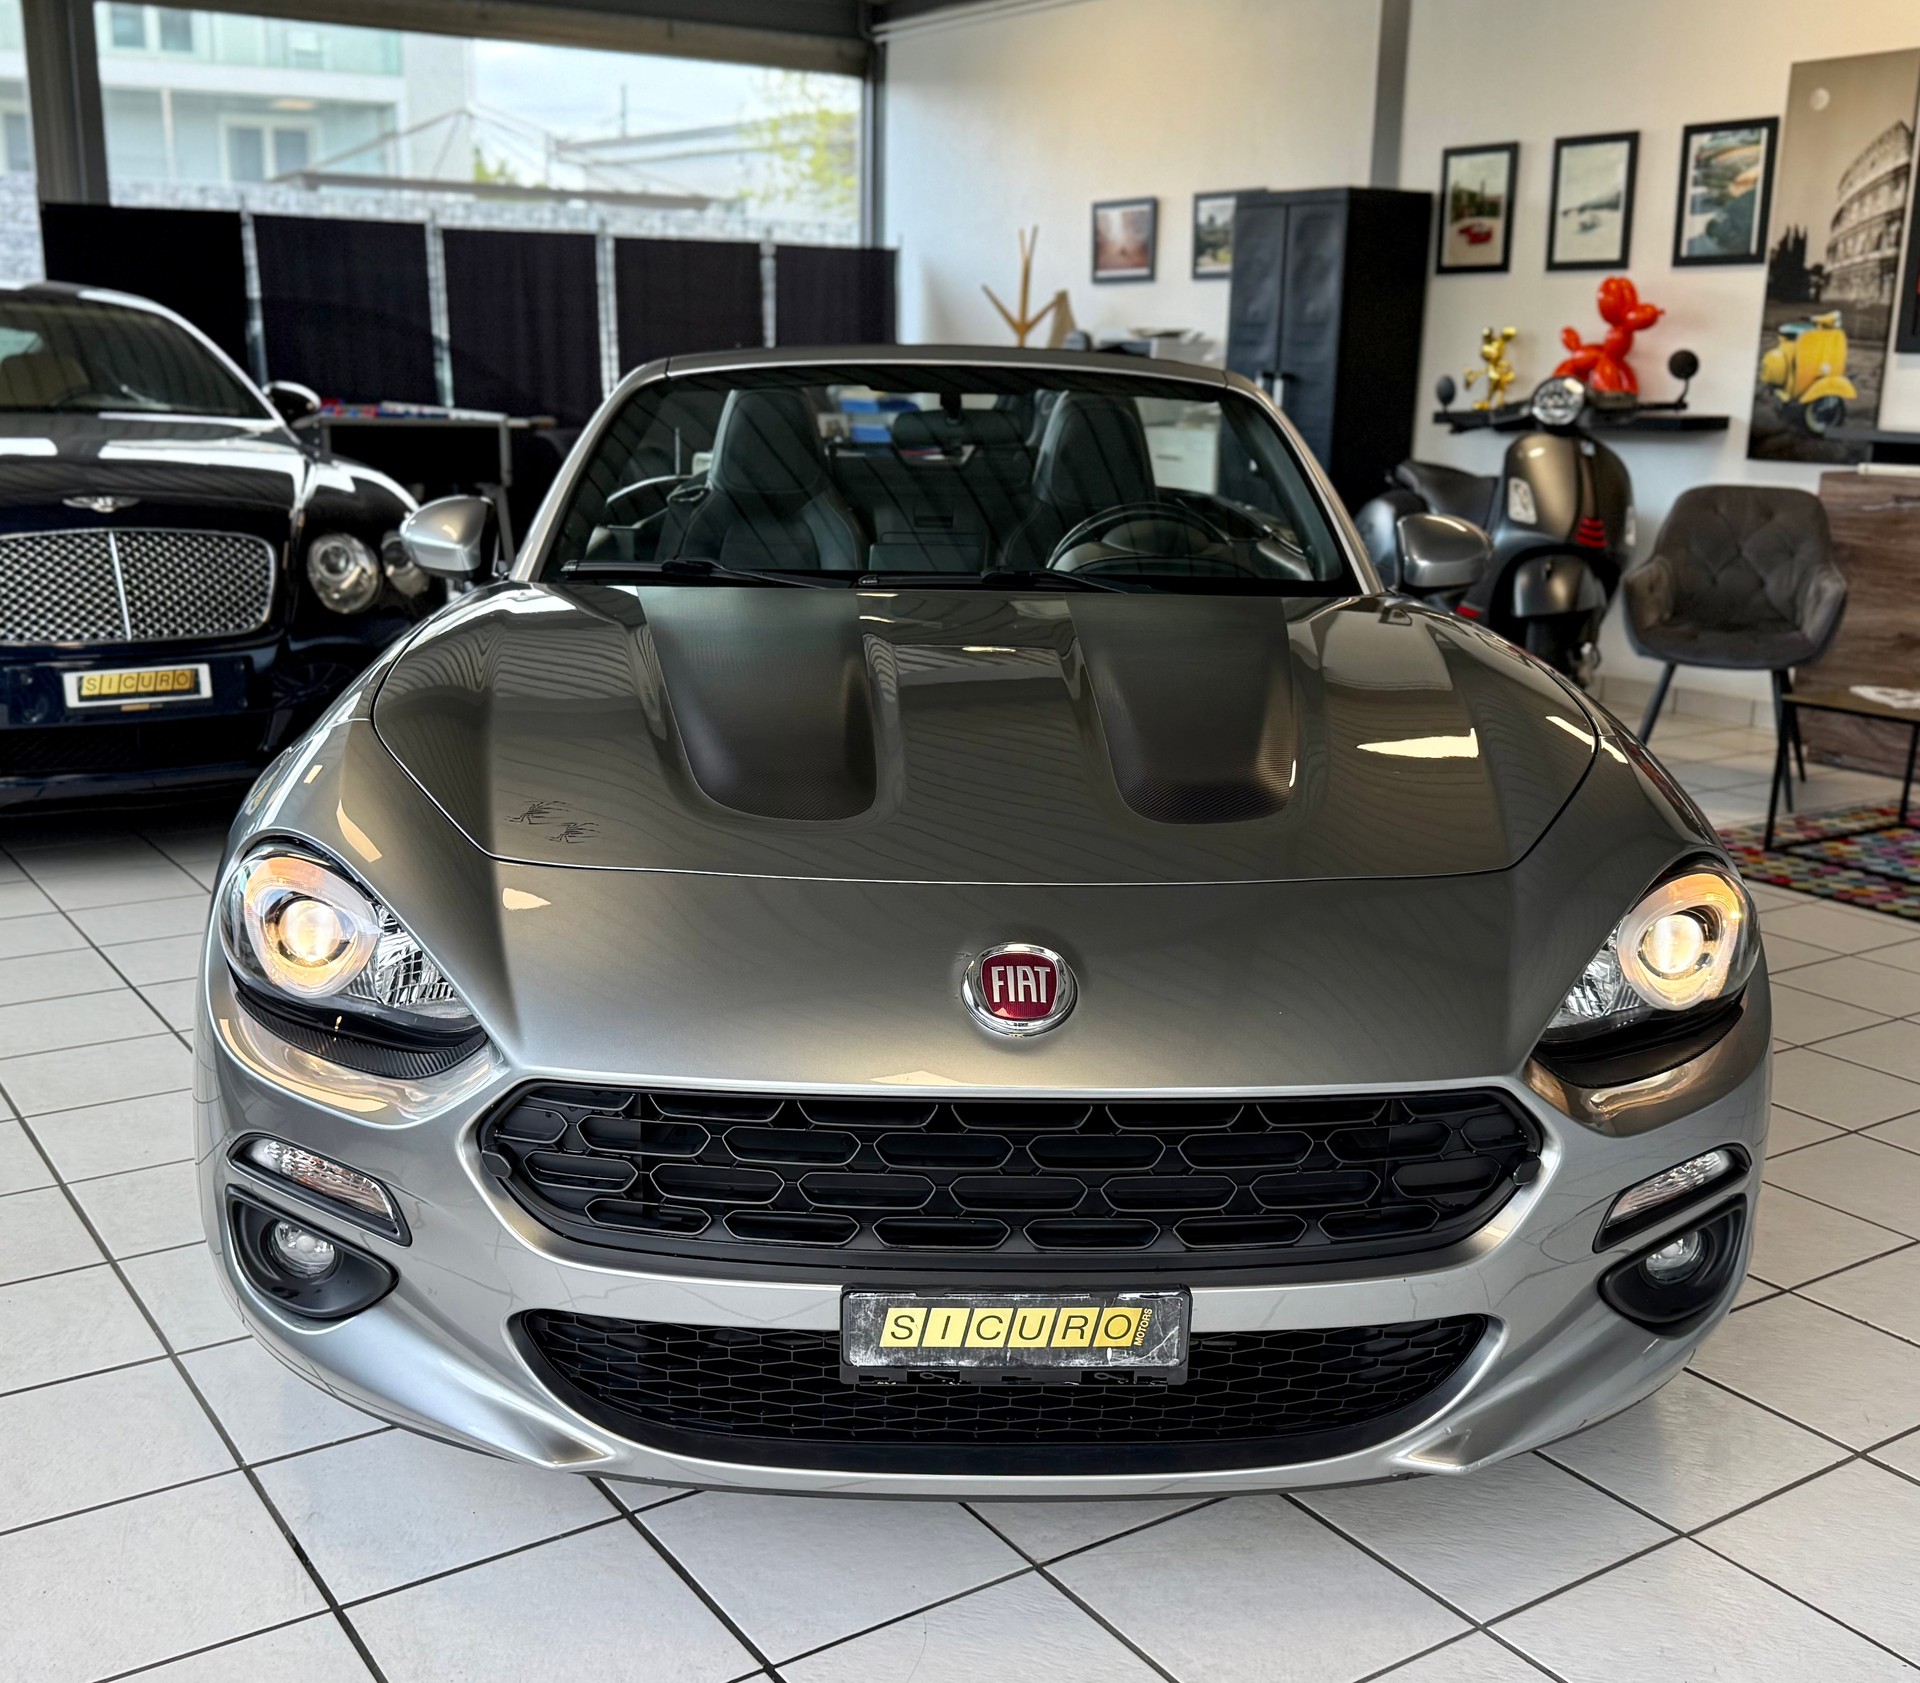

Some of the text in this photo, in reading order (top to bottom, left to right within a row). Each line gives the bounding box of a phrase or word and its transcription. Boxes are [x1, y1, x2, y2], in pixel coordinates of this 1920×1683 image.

[85, 672, 189, 692] SICURO
[990, 965, 1051, 1004] FIAT
[890, 1314, 1133, 1341] SICURO
[1133, 1307, 1153, 1347] MOTORS
